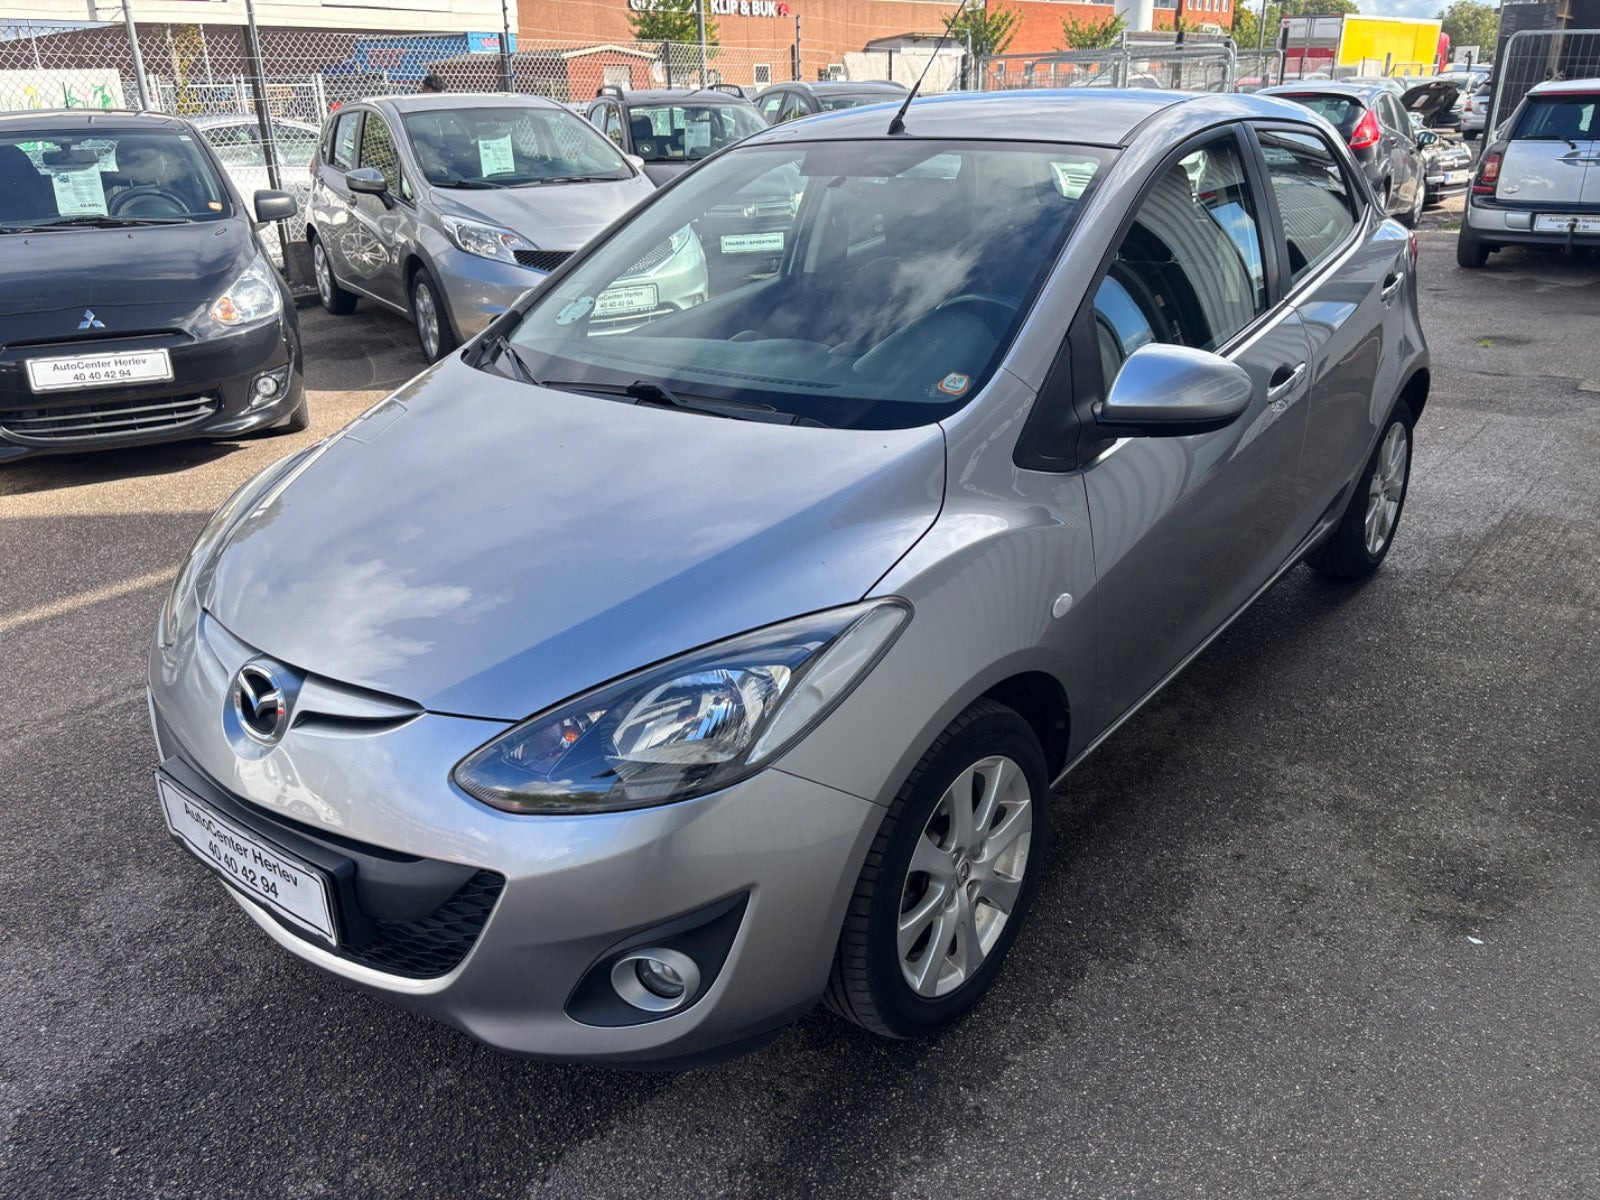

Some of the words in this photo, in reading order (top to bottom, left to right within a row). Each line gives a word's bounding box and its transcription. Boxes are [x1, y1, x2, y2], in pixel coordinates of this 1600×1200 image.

[711, 0, 739, 15] KLIP
[740, 1, 750, 16] &
[752, 1, 777, 17] BUK
[53, 361, 111, 372] AutoCenter
[114, 357, 147, 367] Herlev
[73, 373, 86, 381] 40
[88, 371, 102, 380] 40
[103, 370, 117, 379] 42
[118, 369, 131, 377] 94
[184, 802, 249, 858] AutoCenter
[251, 848, 299, 887] Herlev
[208, 840, 222, 861] 40
[223, 852, 239, 874] 40
[241, 865, 259, 888] 42
[260, 876, 279, 899] 94
